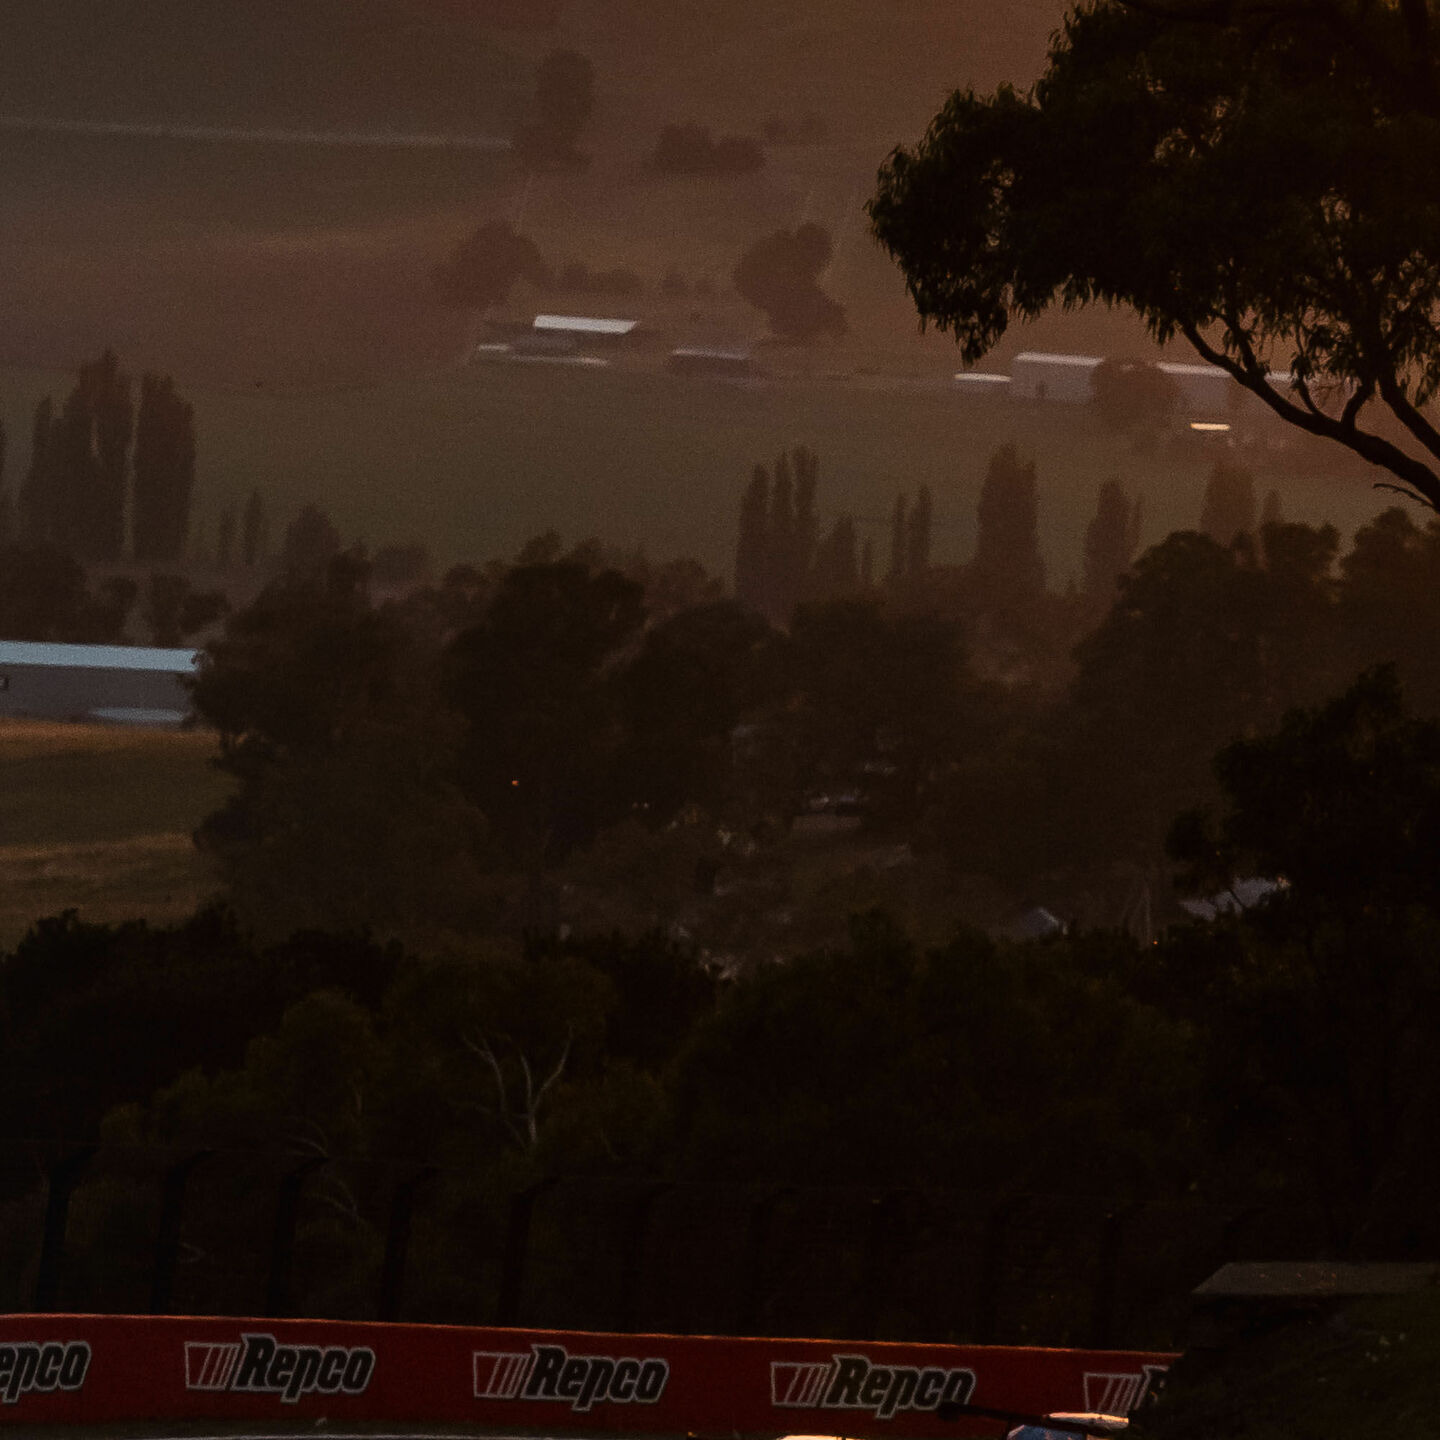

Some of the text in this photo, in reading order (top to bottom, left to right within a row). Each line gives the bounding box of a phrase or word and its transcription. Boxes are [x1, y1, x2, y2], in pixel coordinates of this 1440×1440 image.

[230, 1333, 376, 1403] Repco
[520, 1344, 669, 1411] Repco
[825, 1354, 976, 1420] Repco
